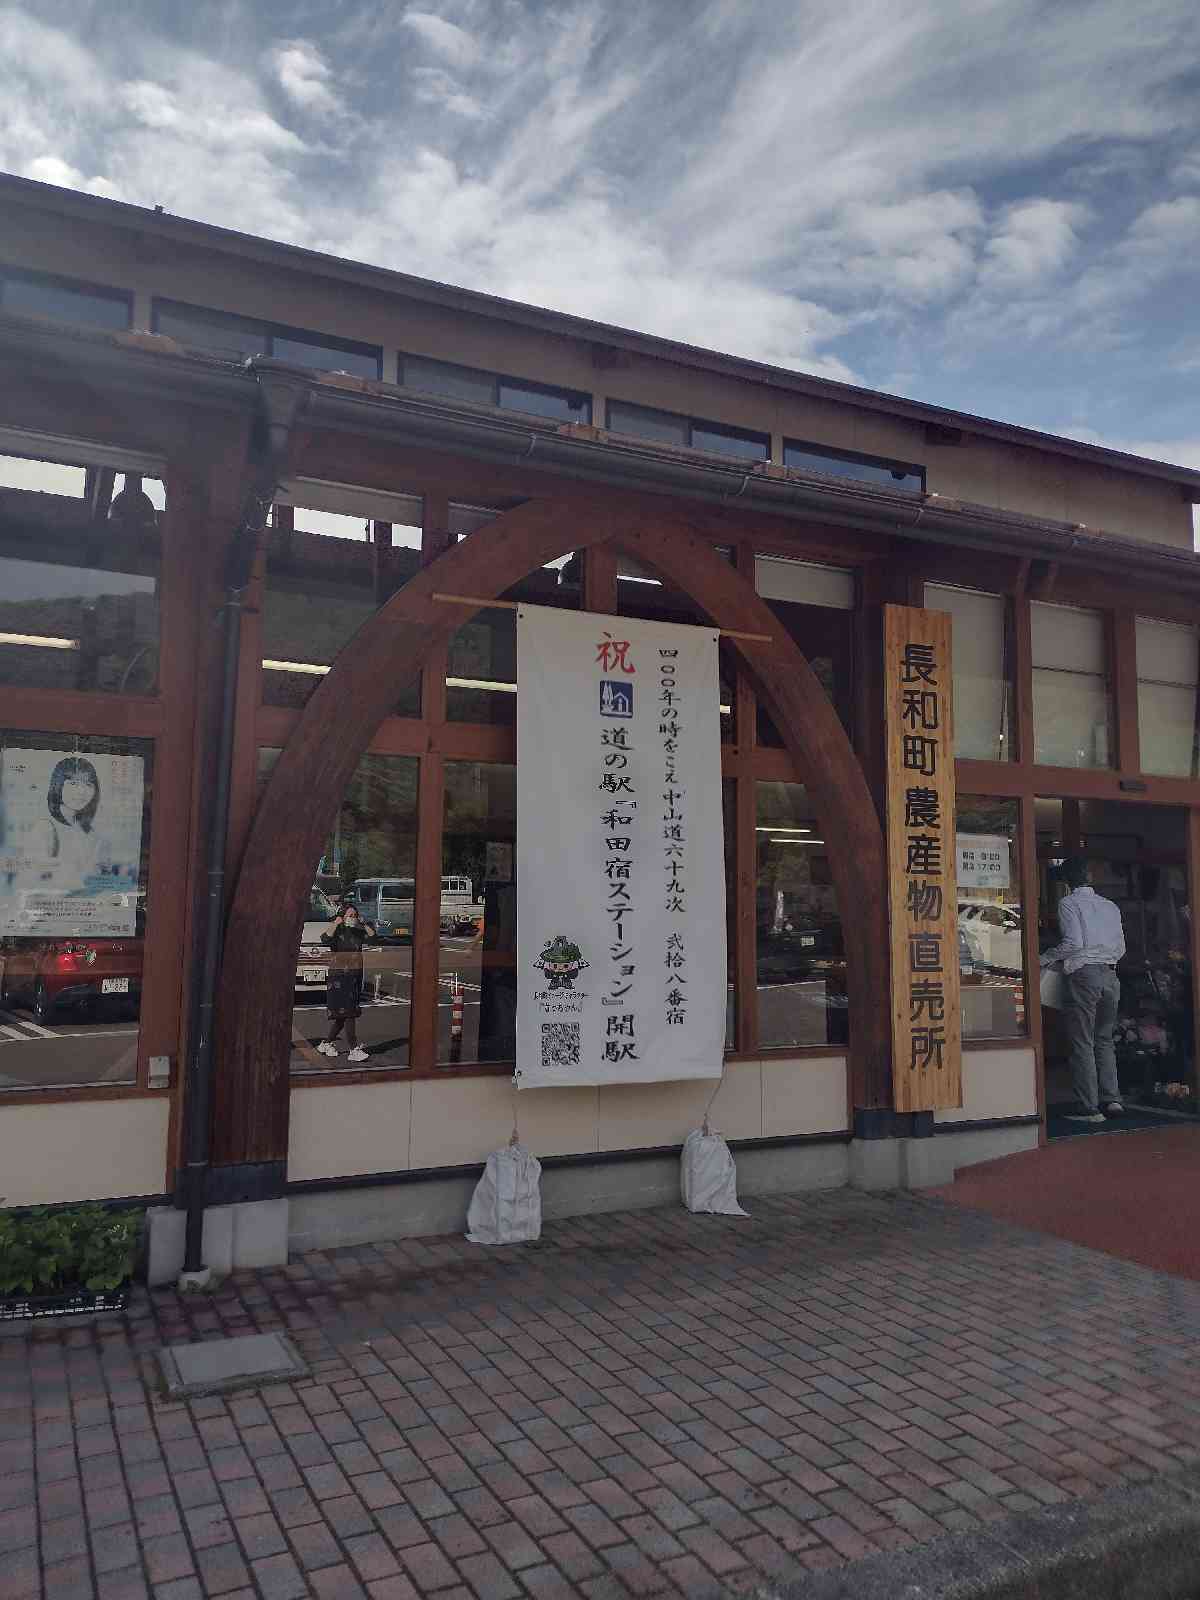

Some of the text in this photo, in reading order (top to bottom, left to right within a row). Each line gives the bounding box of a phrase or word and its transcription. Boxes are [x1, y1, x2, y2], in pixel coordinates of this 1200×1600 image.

[594, 631, 636, 673] 祝
[899, 643, 947, 1071] 長和町農産物直売所
